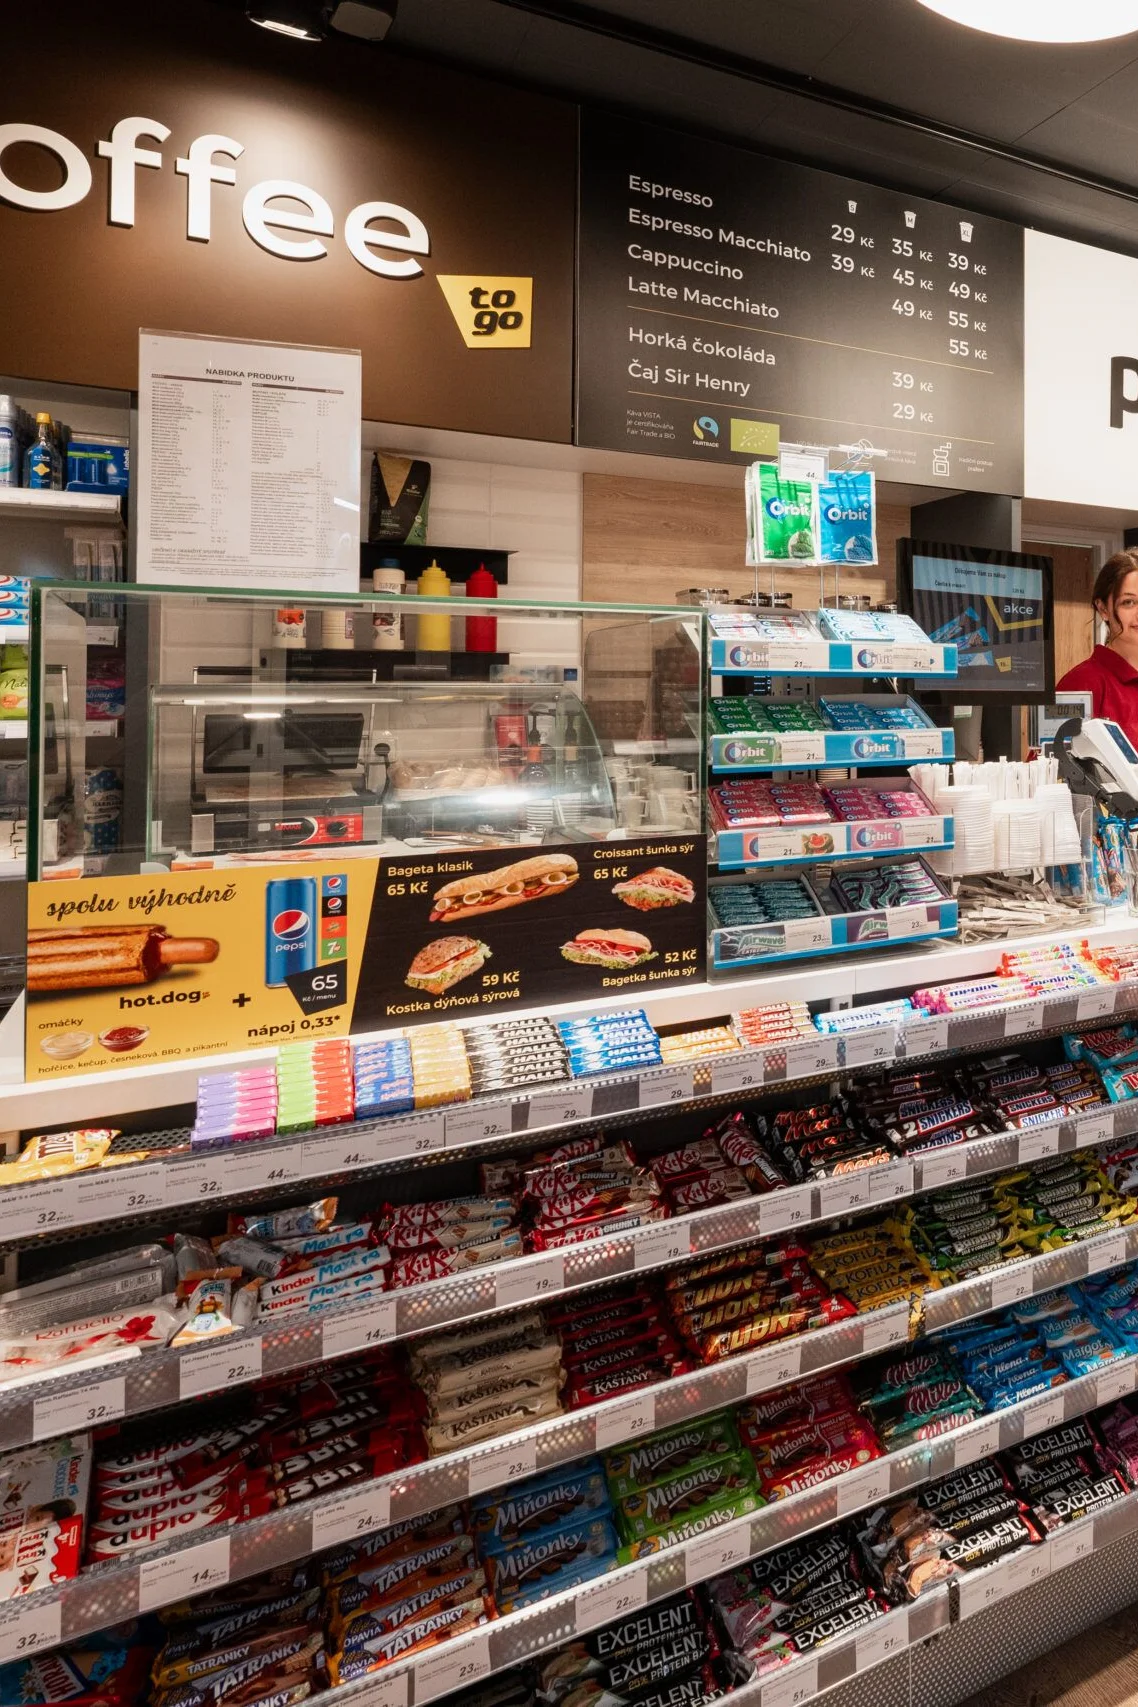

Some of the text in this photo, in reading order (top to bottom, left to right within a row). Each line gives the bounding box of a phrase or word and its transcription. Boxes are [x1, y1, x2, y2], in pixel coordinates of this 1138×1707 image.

[0, 116, 430, 279] offee
[628, 175, 713, 208] Espresso
[628, 208, 811, 262] Espresso Macchiato
[831, 224, 874, 248] 29 Kč
[892, 238, 933, 262] 35 Kč
[627, 244, 744, 281] Cappuccino
[831, 254, 875, 278] 39 Kč
[948, 252, 987, 275] 39 Kč
[892, 268, 933, 291] 45 Kč
[469, 286, 516, 309] to
[628, 277, 779, 319] Latte Macchiato
[948, 281, 987, 303] 49 Kč
[892, 299, 933, 321] 49 Kč
[471, 309, 523, 336] go
[948, 311, 987, 332] 55 Kč
[628, 327, 776, 366] Horká čokoláda
[949, 339, 987, 360] 55 Kč
[628, 359, 750, 396] Čaj Sir Henry
[892, 372, 933, 393] 39 Kč
[892, 403, 933, 423] 29 Kč
[692, 440, 719, 448] FAIRTRADE
[769, 496, 811, 517] Orbit
[828, 502, 868, 521] Orbit
[1004, 603, 1033, 615] akce
[731, 742, 766, 762] Orbit
[861, 738, 890, 756] Orbit
[862, 825, 893, 844] Orbit
[593, 842, 695, 860] Croissant šunka sýr
[387, 860, 473, 878] Bageta klasik
[593, 866, 628, 880] 65 Kč
[387, 881, 428, 896] 65 Kč
[47, 883, 237, 921] spolu výhodně
[275, 940, 307, 953] pepsi
[664, 949, 697, 964] 52 Kč
[312, 974, 338, 991] 65
[482, 971, 520, 986] 59 Kč
[602, 965, 697, 987] Bagetka šunka sýr
[119, 989, 201, 1009] hot.dog
[302, 993, 336, 1003] Kč menu
[386, 987, 520, 1015] Kostka dýňová sýrová
[38, 1016, 84, 1030] omáčky
[248, 1018, 295, 1037] nápoj
[162, 1047, 181, 1057] BBQ
[193, 1040, 228, 1053] pikantní
[610, 1051, 657, 1065] HALLS
[513, 1069, 565, 1084] HALLS
[920, 1101, 972, 1131] SNICKERS
[654, 1150, 697, 1173] KitKat
[531, 1172, 616, 1197] KitKat CHUNKY
[604, 1217, 639, 1233] CHUNKY
[271, 1256, 358, 1295] Kinder Maxi
[857, 1276, 907, 1297] KOFILA
[728, 1314, 791, 1350] LION
[924, 1466, 998, 1508] EXCELENT
[958, 1478, 1004, 1502] PROTEIN BAR
[110, 1509, 195, 1547] duplo
[946, 1517, 1022, 1558] EXCELENT
[381, 1608, 464, 1659] TATRANKY
[597, 1602, 693, 1654] EXCELENT
[186, 1646, 251, 1674] TATRANKY
[211, 1643, 301, 1698] TATRANKY
